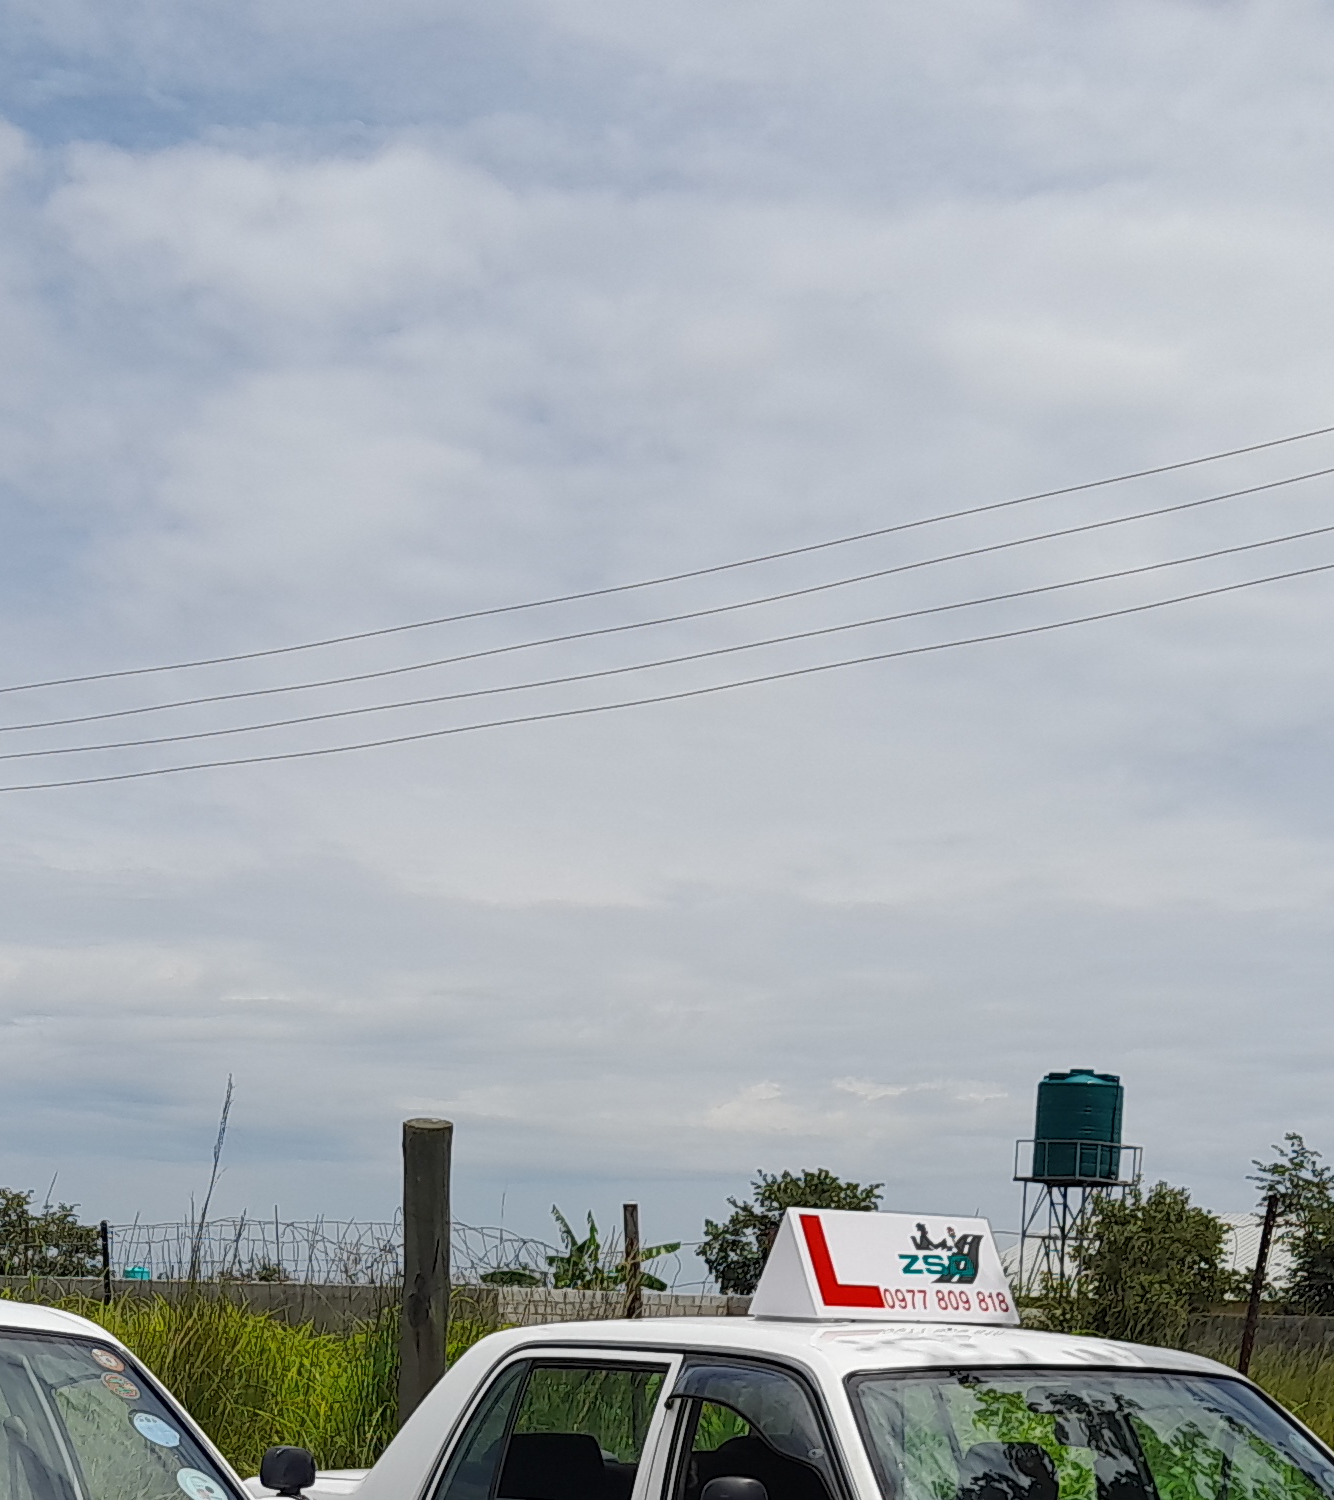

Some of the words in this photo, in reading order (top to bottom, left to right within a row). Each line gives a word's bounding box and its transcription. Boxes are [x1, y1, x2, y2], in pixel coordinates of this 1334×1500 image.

[799, 1214, 885, 1308] L
[883, 1287, 927, 1310] 0977
[935, 1289, 972, 1312] 809
[976, 1290, 1010, 1313] 818
